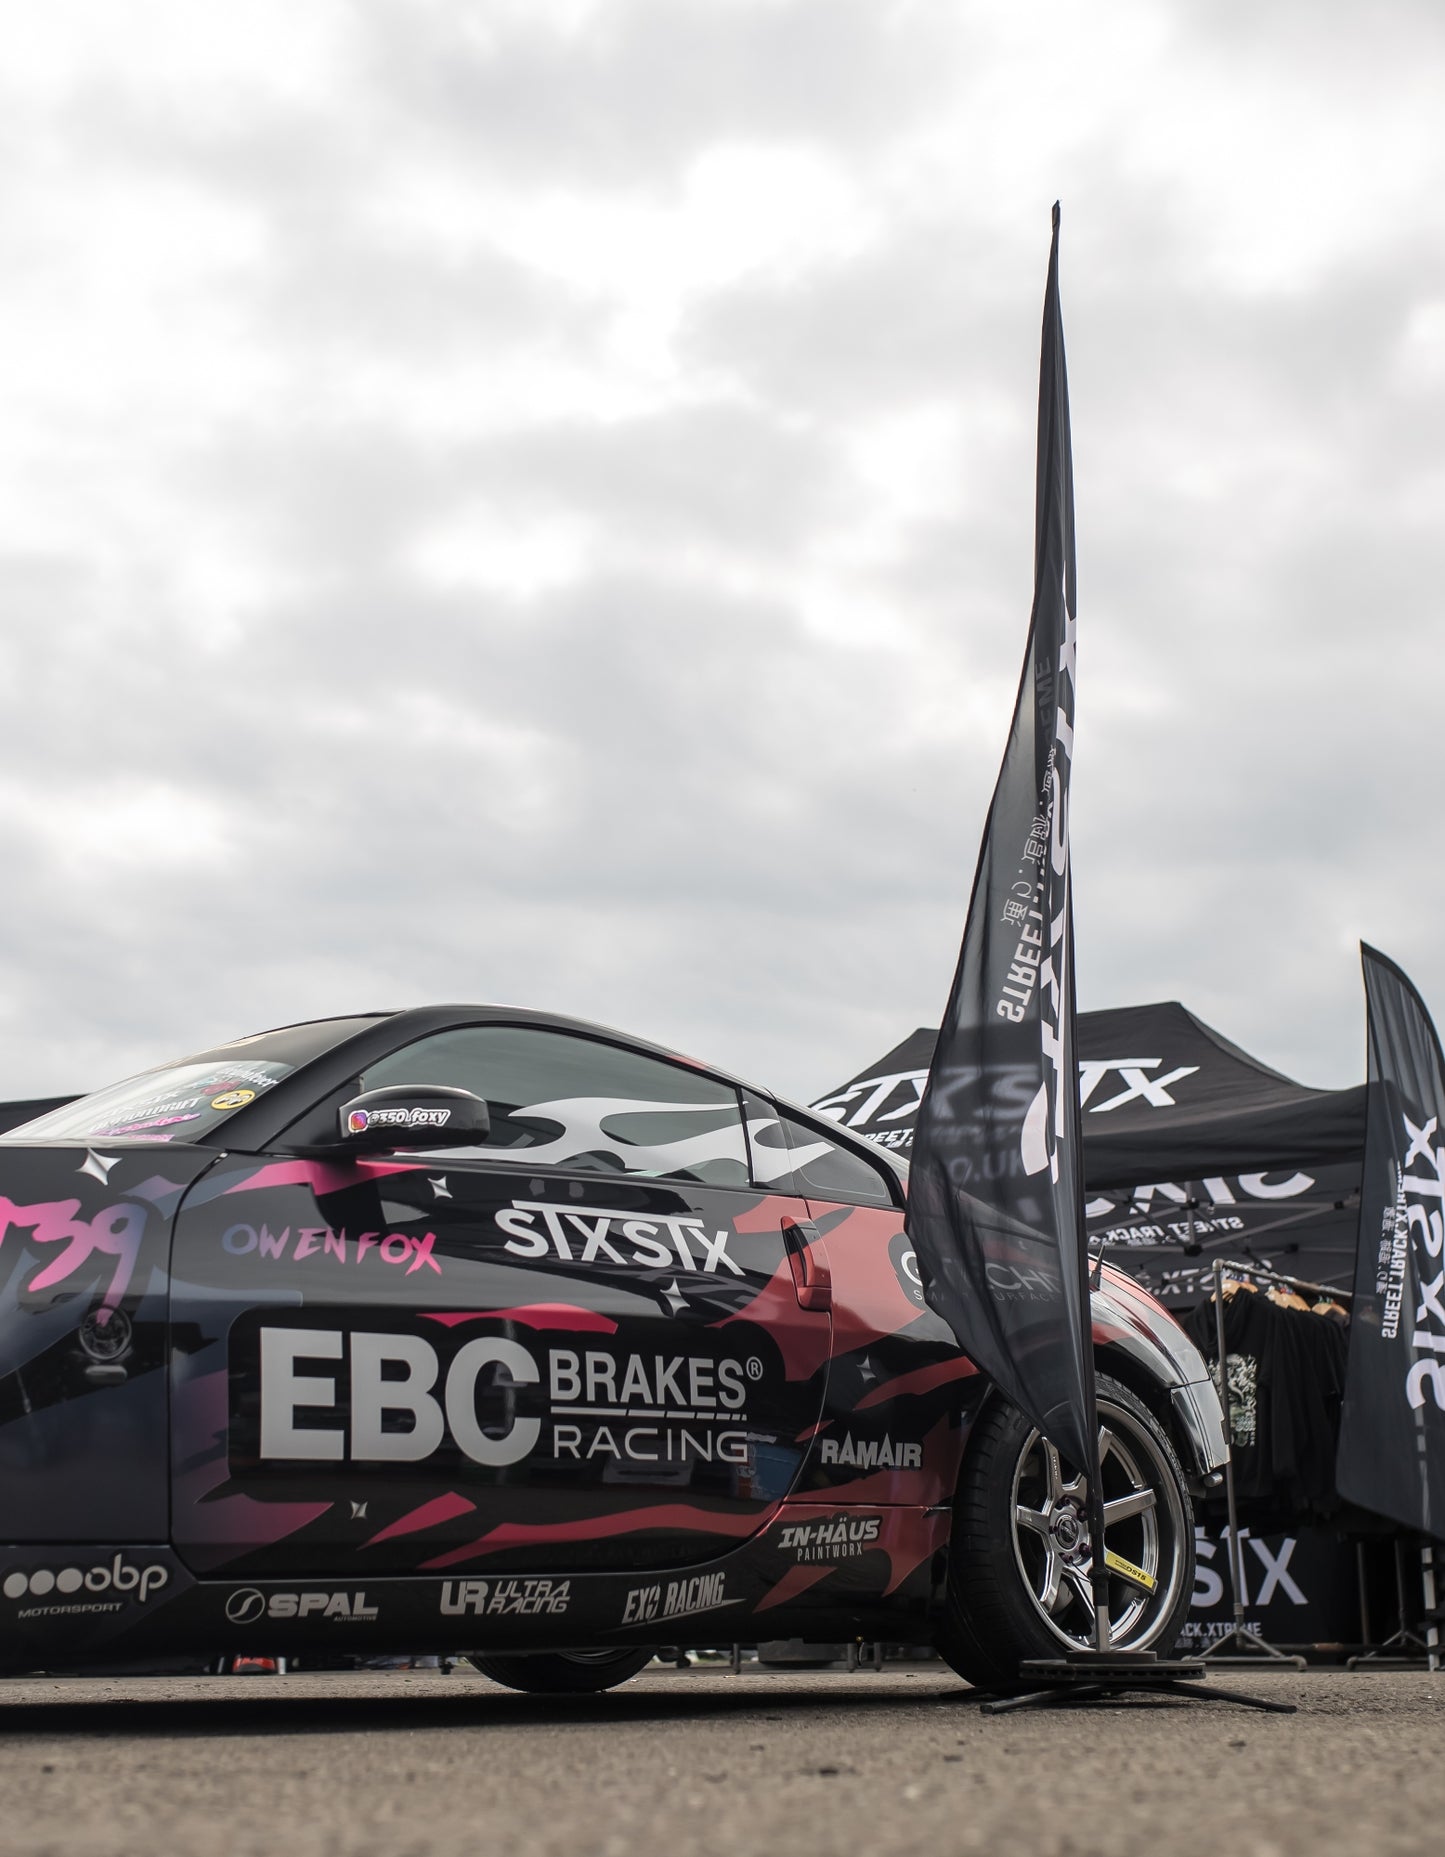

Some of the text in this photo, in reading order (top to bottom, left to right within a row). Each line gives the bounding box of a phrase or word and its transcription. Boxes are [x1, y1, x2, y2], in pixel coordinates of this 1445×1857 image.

[221, 1222, 443, 1277] OWEN FOX
[494, 1199, 746, 1276] STXSTX
[260, 1326, 542, 1467] EBC
[553, 1424, 749, 1463] RACING
[820, 1430, 922, 1470] RAMAIR
[778, 1516, 881, 1549] IN-HÄUS
[797, 1541, 863, 1562] PAINTWORX
[84, 1553, 169, 1603] obp
[494, 1580, 571, 1598] ULTRA
[663, 1571, 726, 1616] RACING
[18, 1601, 123, 1619] MOTORSPORT
[267, 1592, 379, 1619] SPAL
[486, 1596, 569, 1615] RACING
